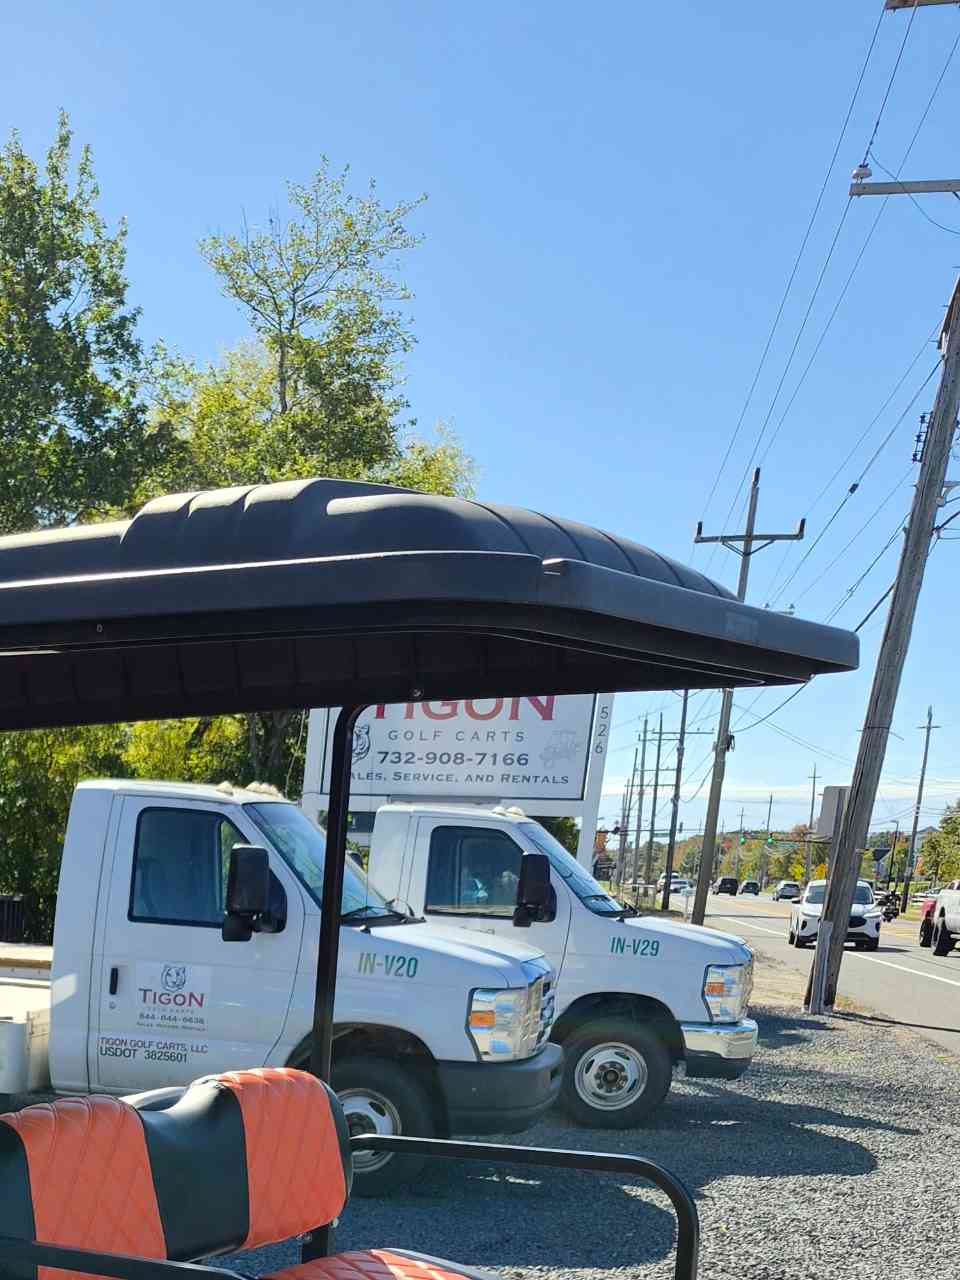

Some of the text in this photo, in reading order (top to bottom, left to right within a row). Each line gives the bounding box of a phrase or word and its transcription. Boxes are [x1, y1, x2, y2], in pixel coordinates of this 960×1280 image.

[387, 729, 526, 742] GOLF CARTS
[377, 751, 529, 767] 732-908-7166
[464, 774, 495, 784] AND
[500, 773, 569, 785] RENTALS
[610, 936, 660, 957] IN-V29
[358, 952, 419, 979] IN-V20
[138, 988, 205, 1008] TIGON
[100, 1036, 128, 1047] TIGON
[129, 1039, 155, 1049] GOLF
[190, 1043, 208, 1054] LLC
[100, 1046, 138, 1059] USDOT
